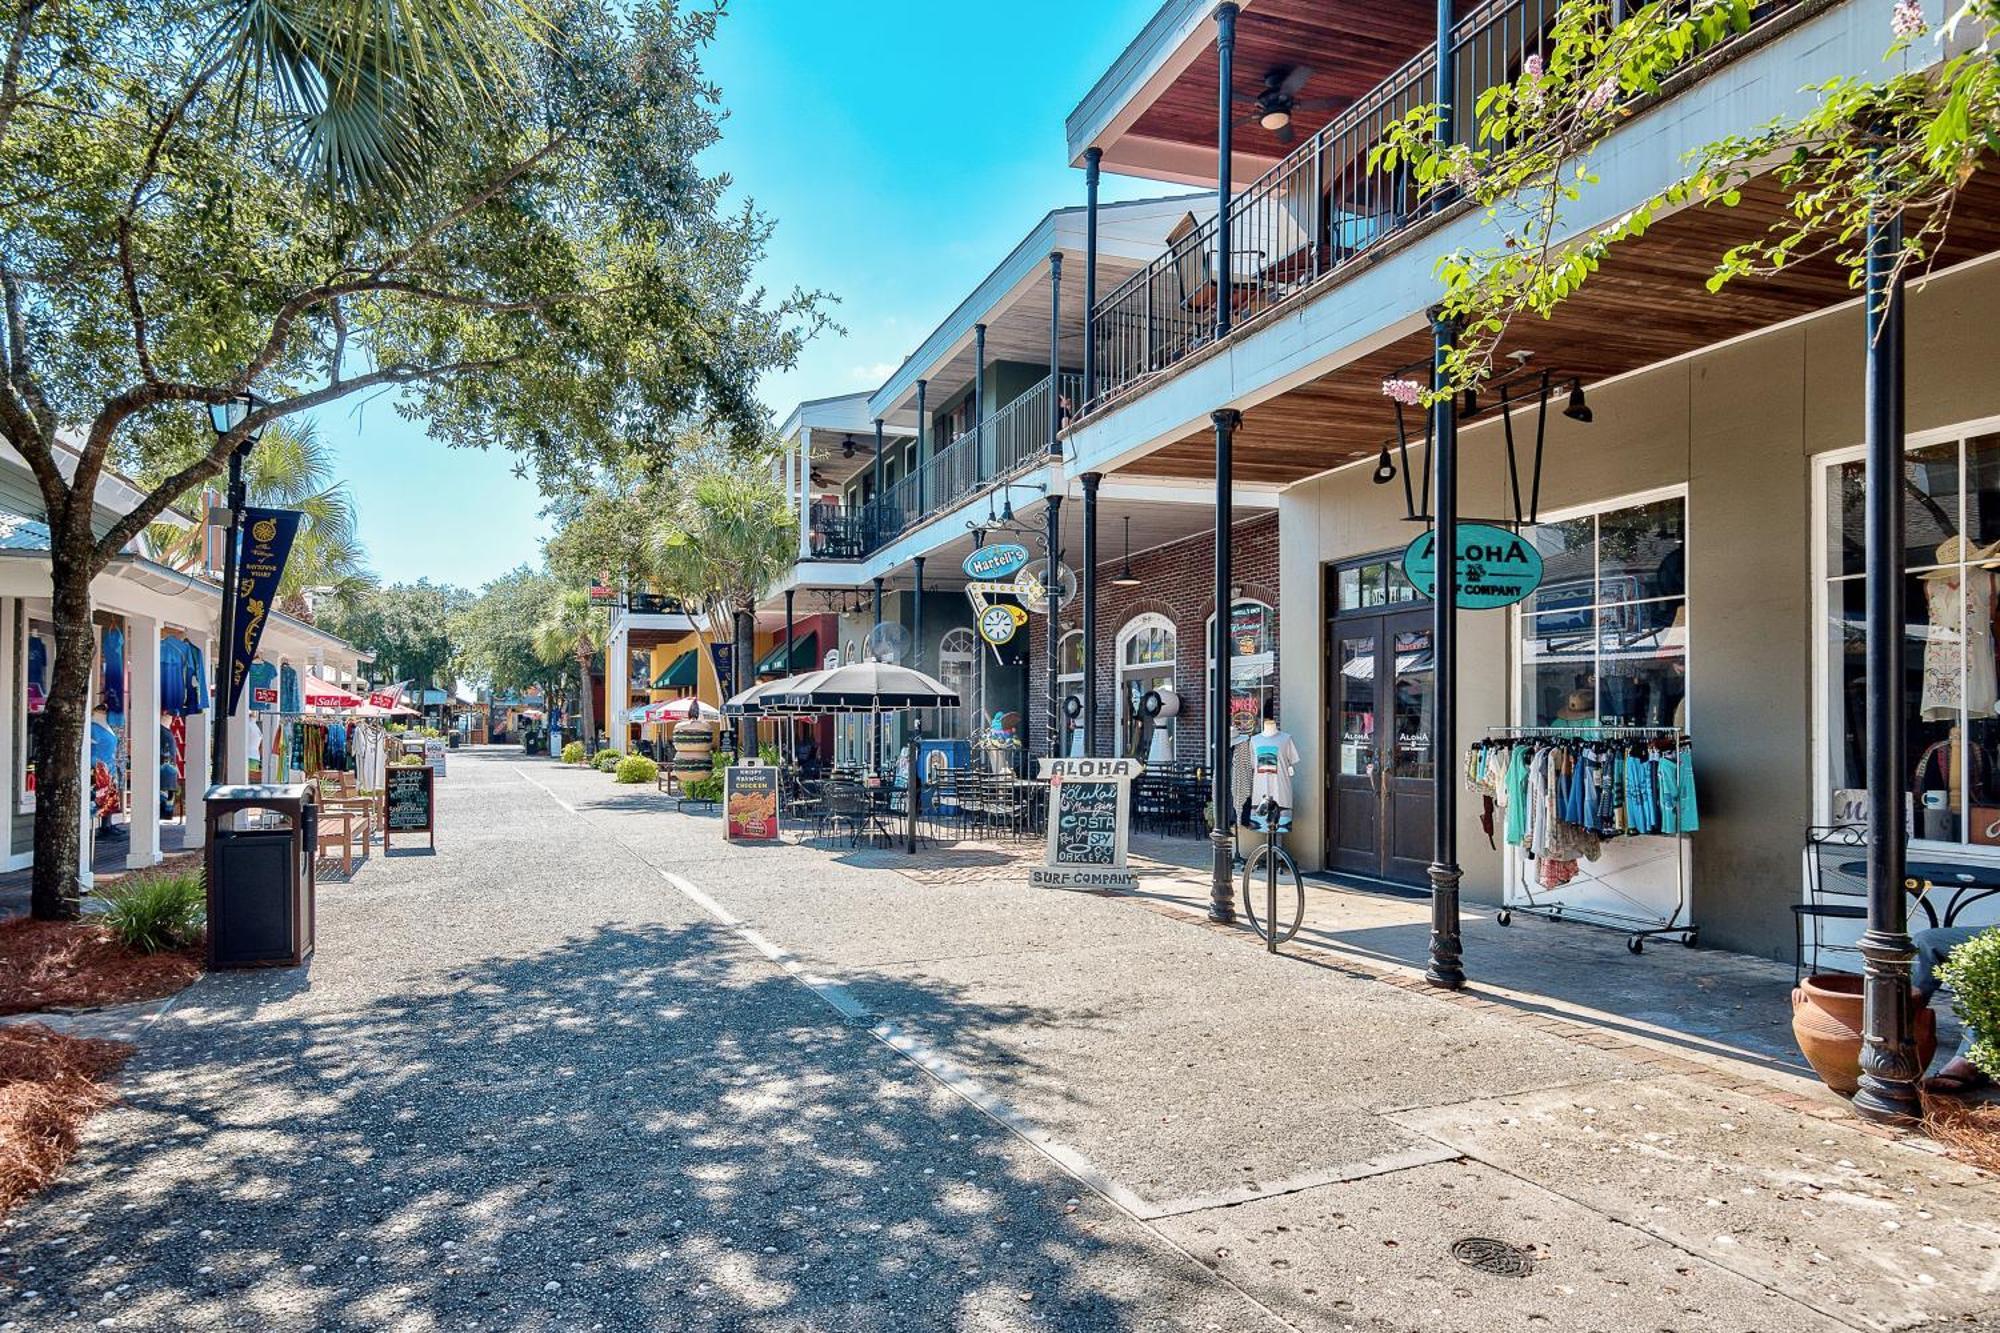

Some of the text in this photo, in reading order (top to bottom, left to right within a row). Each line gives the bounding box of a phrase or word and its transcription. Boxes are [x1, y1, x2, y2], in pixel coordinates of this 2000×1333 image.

[972, 550, 1024, 573] Hartell's
[1428, 584, 1522, 596] SF COMPANY
[316, 696, 339, 707] Sale
[1343, 732, 1369, 740] ALOHA
[1400, 733, 1429, 741] ALOHA
[1051, 760, 1129, 777] ALOHA
[1061, 815, 1116, 829] COSTA
[1090, 833, 1112, 844] SPY
[1033, 871, 1133, 885] SURF COMPANY
